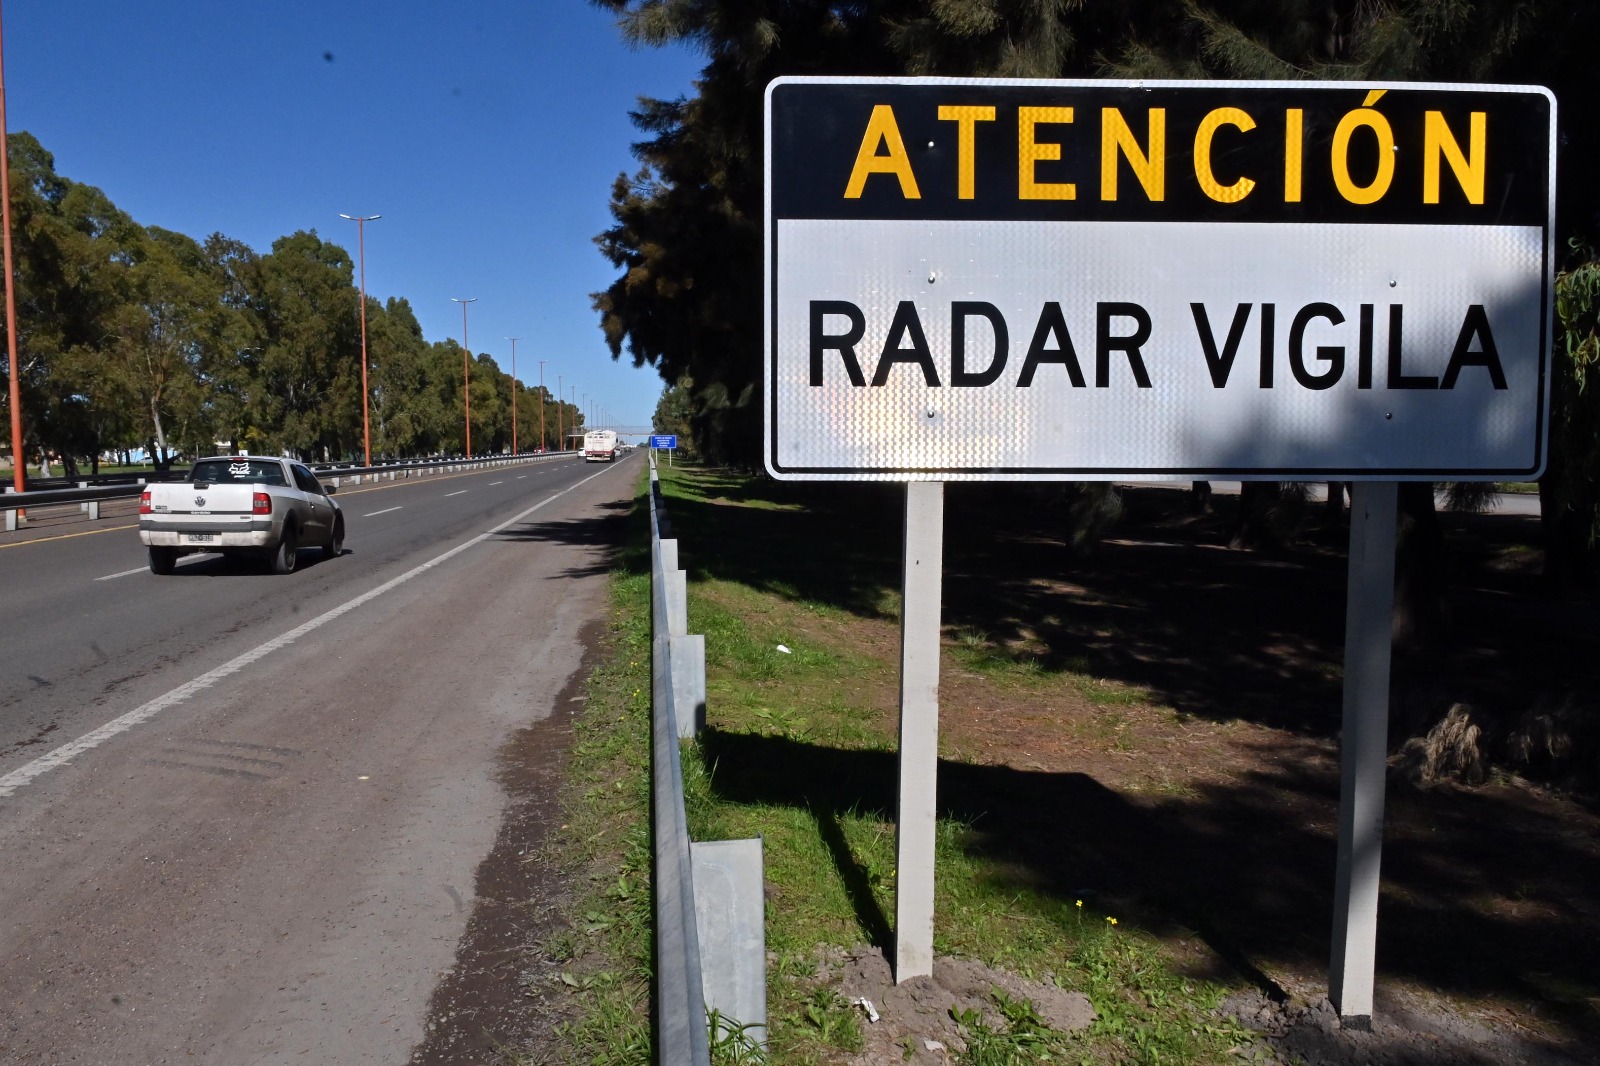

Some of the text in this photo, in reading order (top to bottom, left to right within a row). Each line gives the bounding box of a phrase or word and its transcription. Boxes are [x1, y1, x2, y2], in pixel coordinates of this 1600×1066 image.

[843, 89, 1487, 205] ATENCIÓN
[809, 300, 1509, 391] RADAR VIGILA
